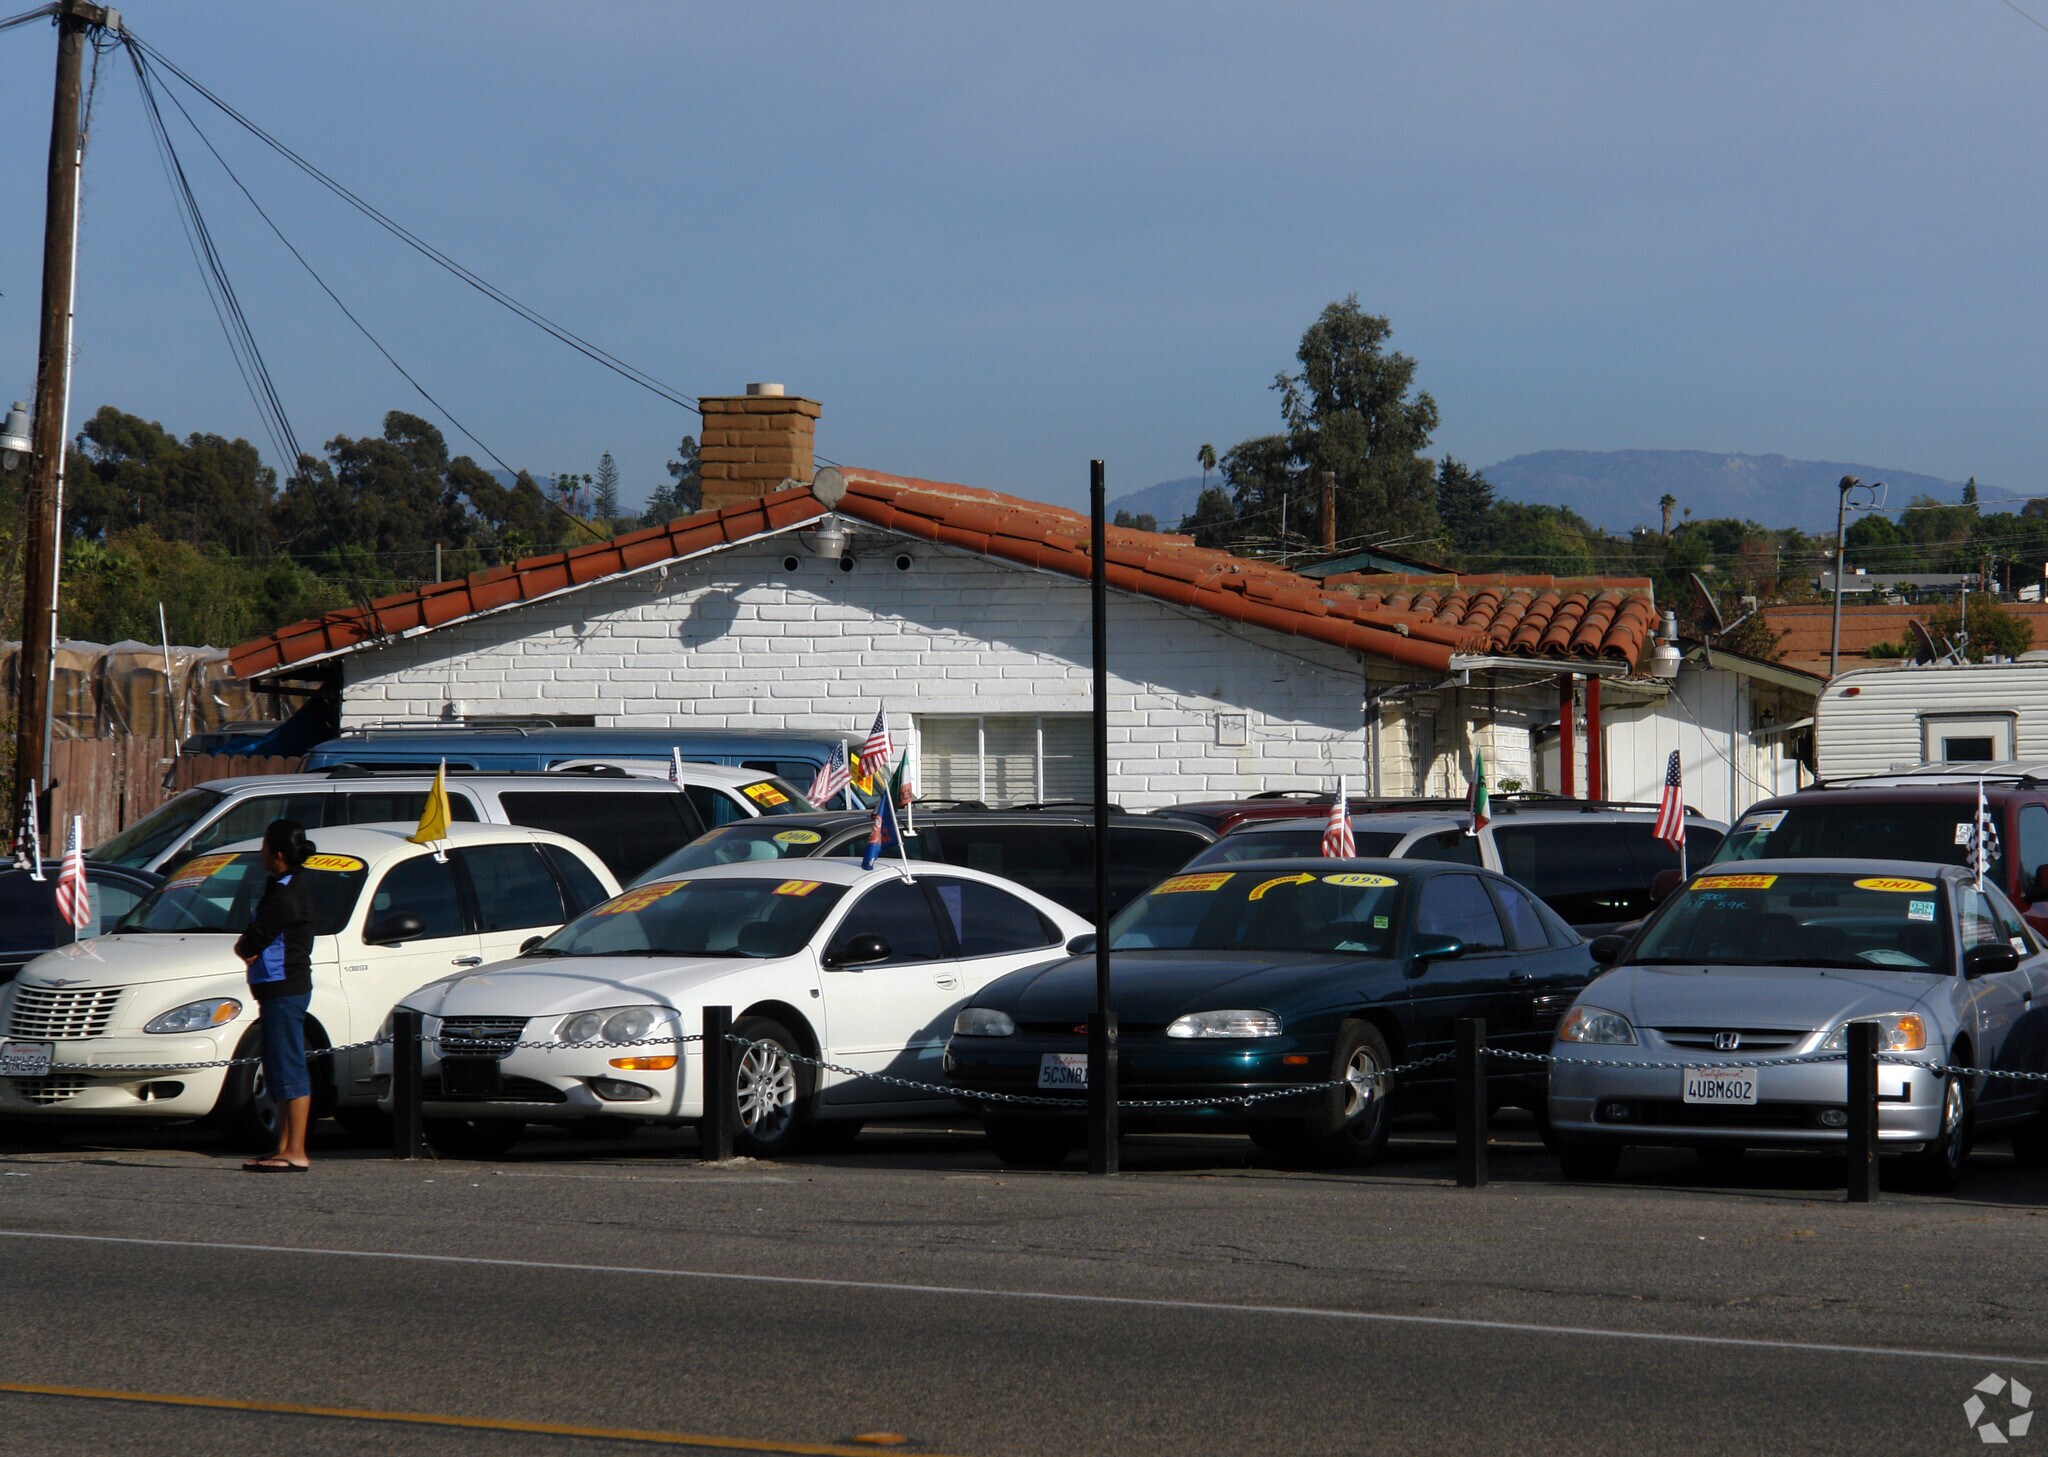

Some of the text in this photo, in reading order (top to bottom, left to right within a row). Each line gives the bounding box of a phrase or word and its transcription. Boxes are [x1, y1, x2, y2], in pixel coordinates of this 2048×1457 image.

[781, 832, 812, 841] 2000
[305, 857, 355, 868] 2004
[1339, 876, 1382, 884] 1998
[1699, 875, 1771, 883] SPORTY
[776, 880, 820, 896] 01
[1869, 880, 1921, 889] 2001
[1055, 1057, 1088, 1066] Californi
[1043, 1066, 1088, 1084] 5CSN81
[1700, 1067, 1743, 1080] California
[1689, 1080, 1752, 1099] 4UBM602
